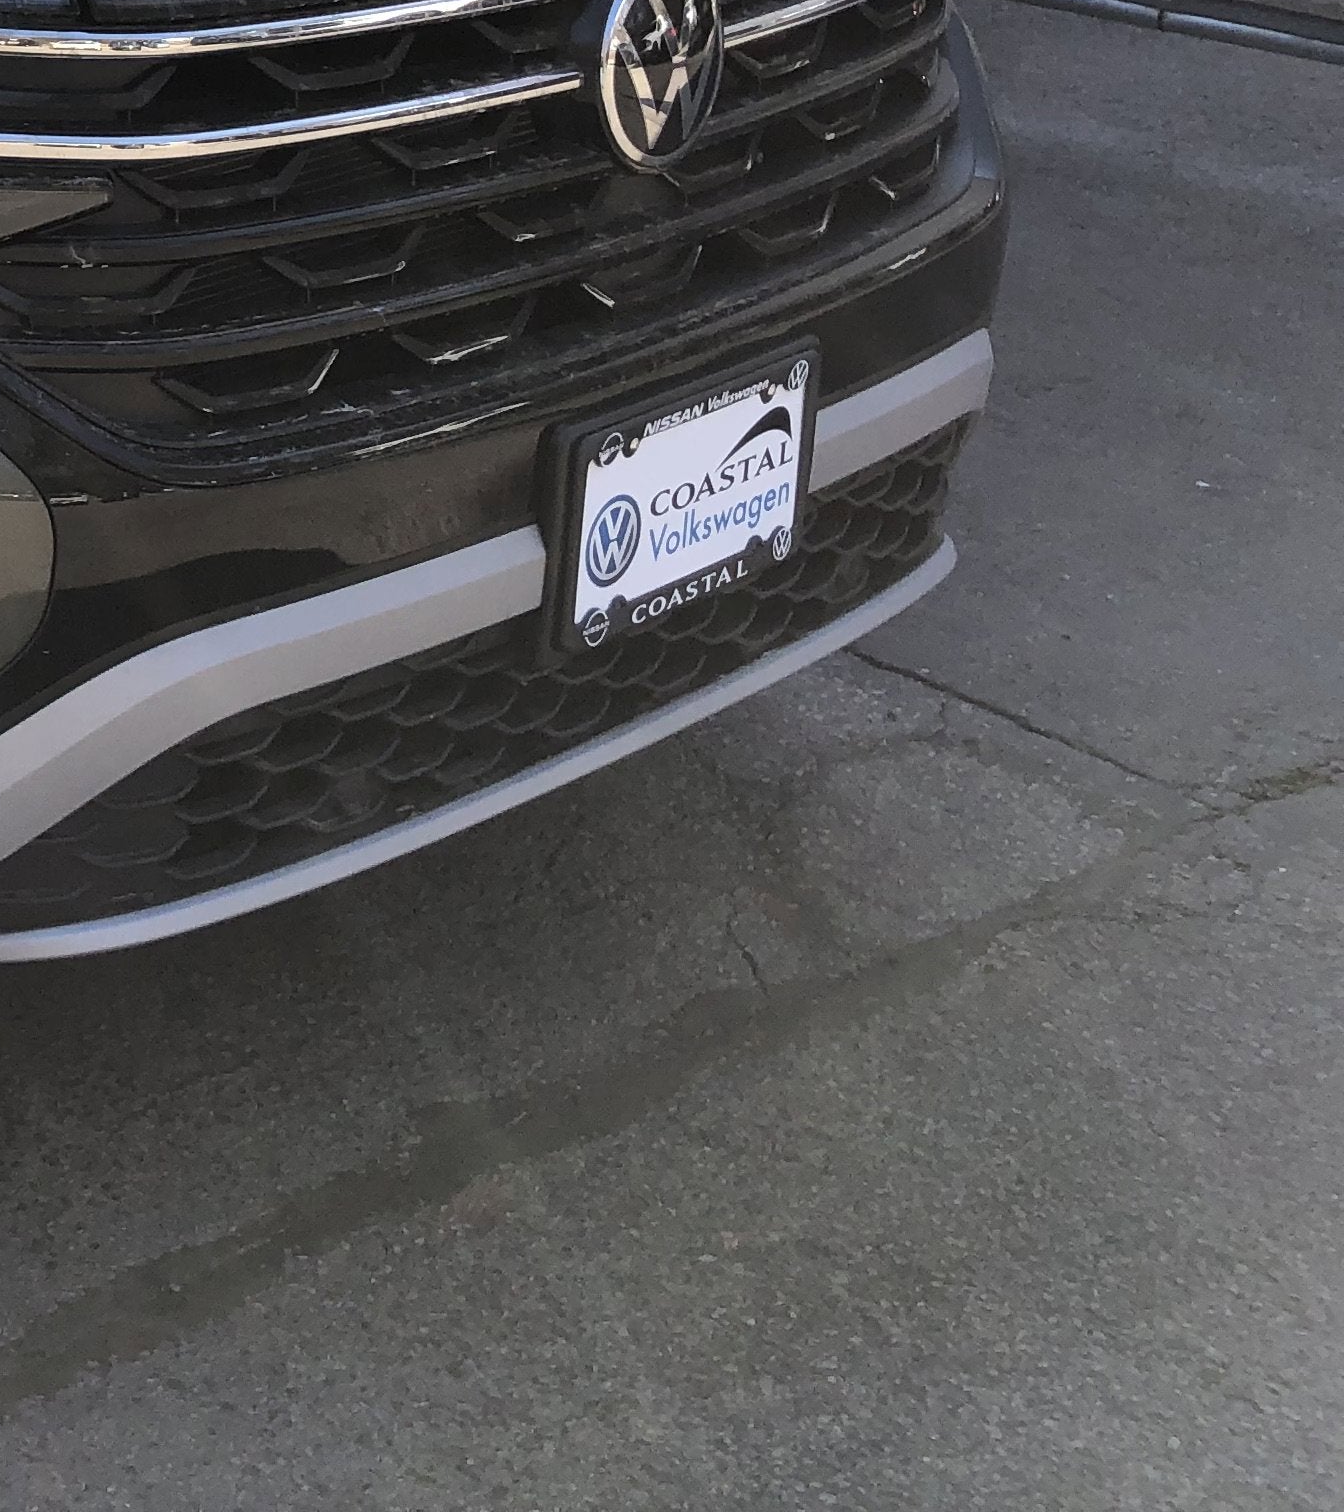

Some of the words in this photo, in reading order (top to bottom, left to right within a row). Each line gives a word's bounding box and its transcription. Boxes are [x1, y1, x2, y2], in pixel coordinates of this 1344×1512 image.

[643, 402, 705, 438] NISSAN
[708, 378, 770, 411] Volkswagen
[650, 441, 794, 517] COASTAL
[648, 481, 791, 562] Volkswagen
[631, 559, 749, 625] COASTAL
